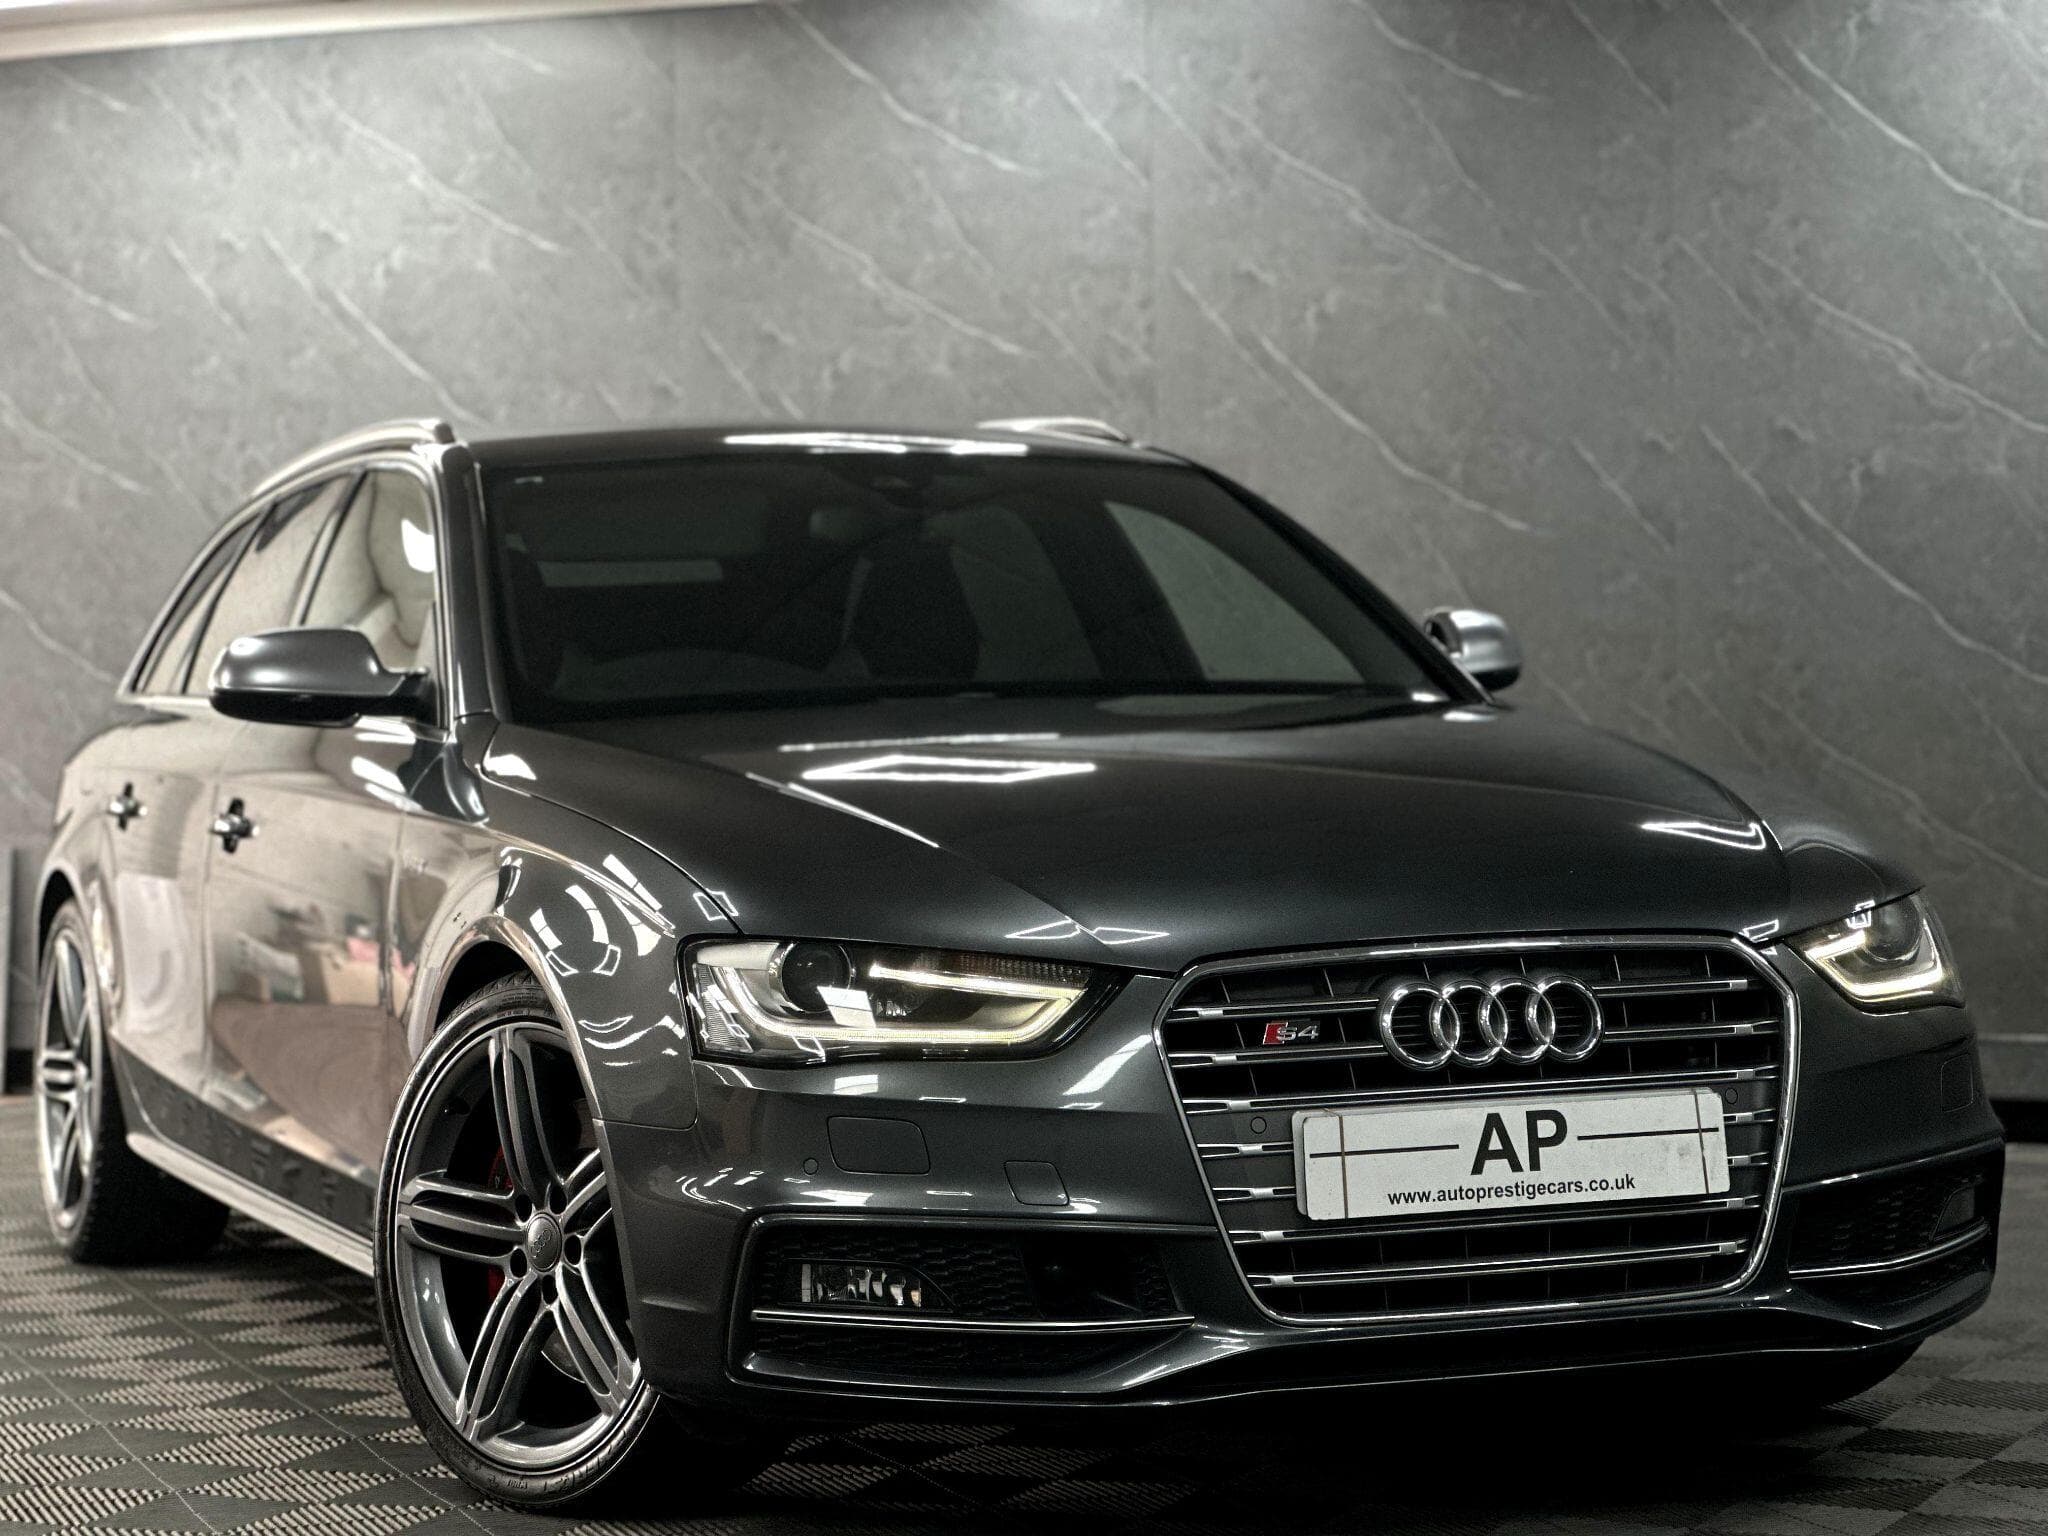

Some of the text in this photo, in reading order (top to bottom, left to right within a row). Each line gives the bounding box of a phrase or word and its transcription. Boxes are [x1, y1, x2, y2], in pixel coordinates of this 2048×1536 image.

[1273, 1023, 1320, 1042] S4
[1470, 1109, 1568, 1176] AP
[1387, 1173, 1636, 1206] www.autoprestigecars.co.uk
